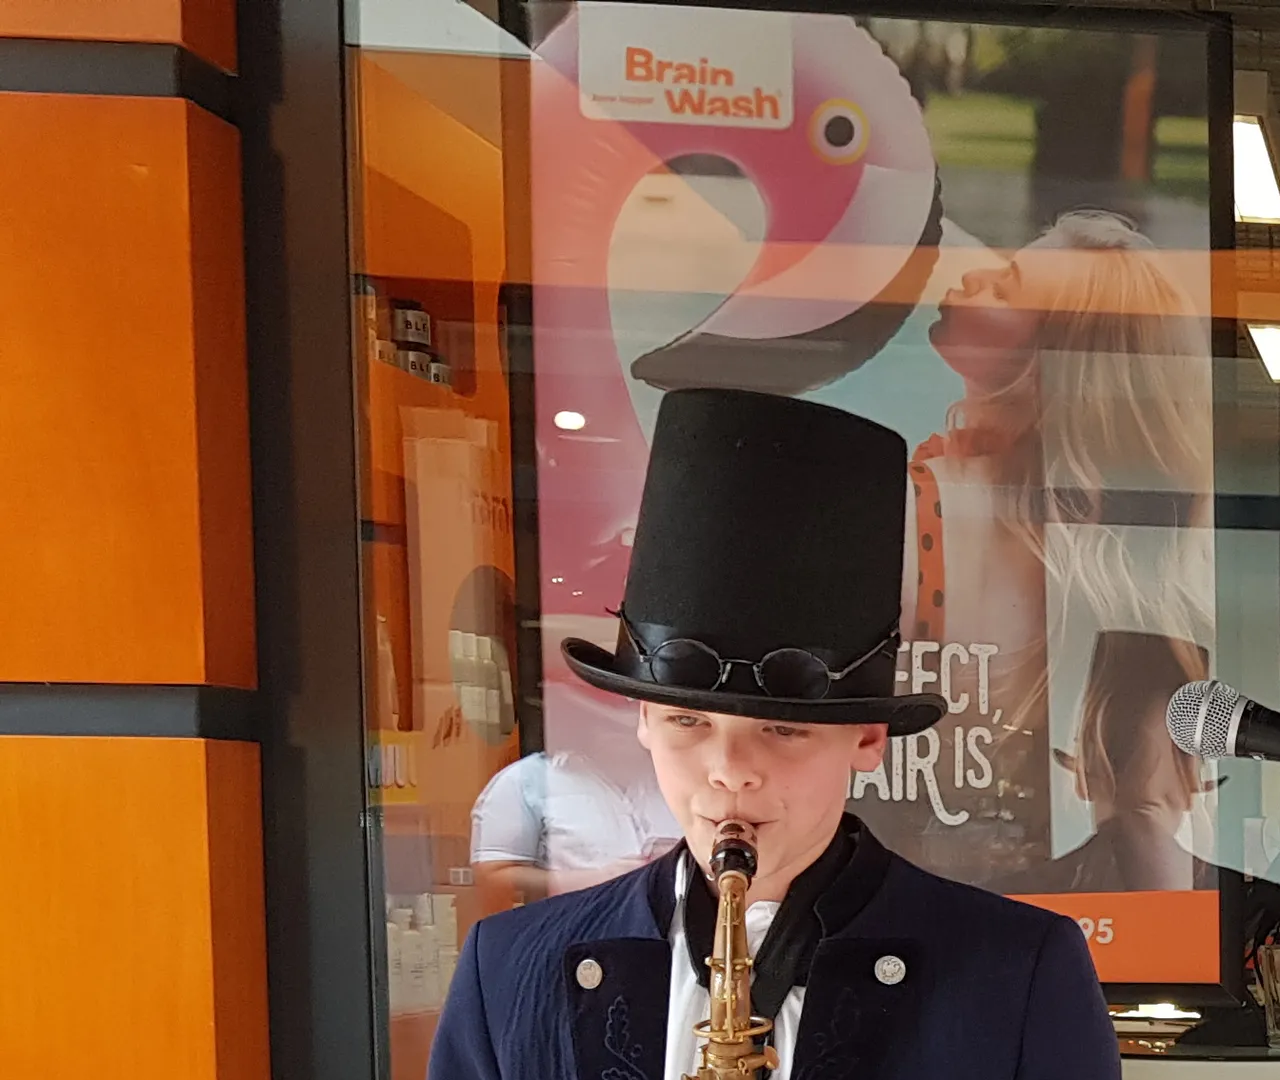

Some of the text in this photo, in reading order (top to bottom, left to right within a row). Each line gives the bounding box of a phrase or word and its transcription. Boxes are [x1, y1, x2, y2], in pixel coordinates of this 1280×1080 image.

[626, 46, 733, 86] Brain
[665, 87, 780, 120] Wash
[847, 726, 993, 826] AIR IS
